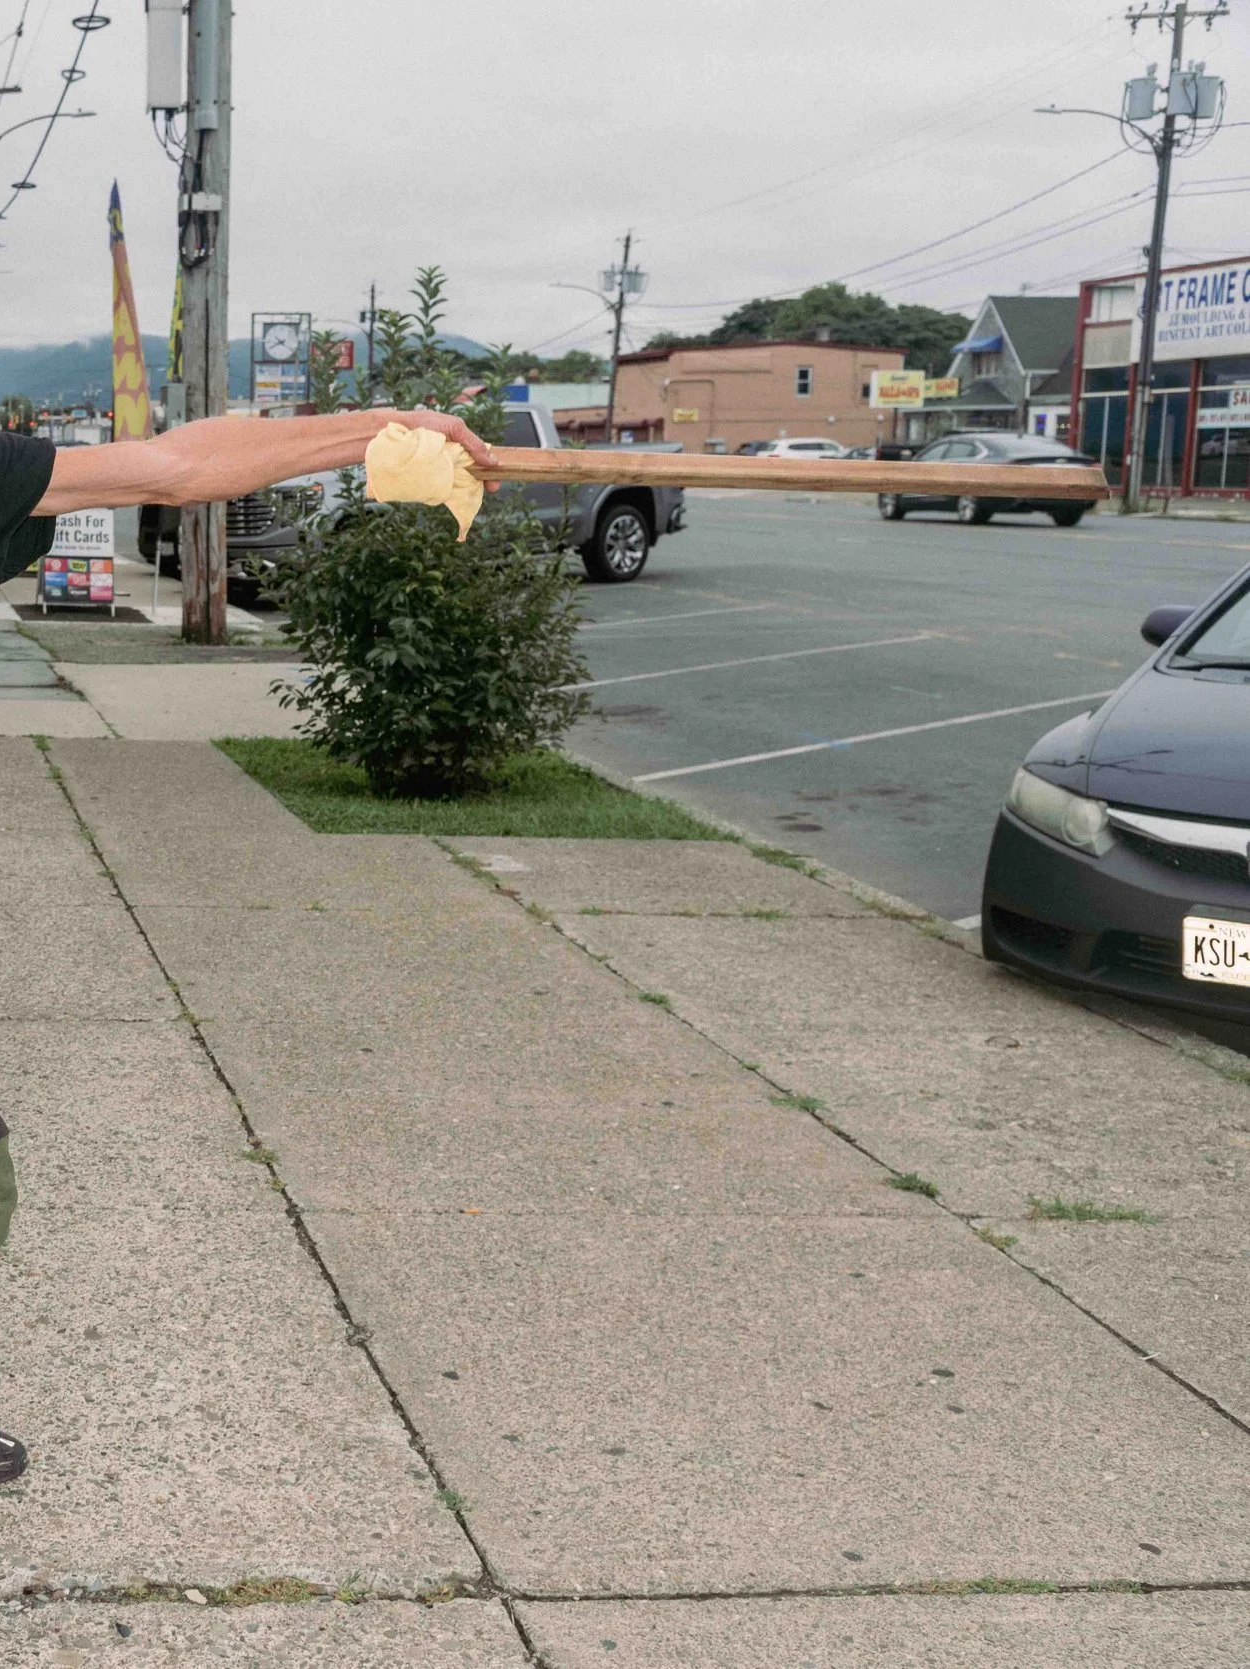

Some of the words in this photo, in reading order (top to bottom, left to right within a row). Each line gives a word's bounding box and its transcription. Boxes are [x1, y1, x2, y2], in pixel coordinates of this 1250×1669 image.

[1175, 271, 1238, 311] FRAME
[1226, 320, 1250, 336] COL
[1233, 390, 1250, 406] SA
[56, 515, 81, 528] ash
[86, 515, 105, 528] For
[55, 530, 70, 543] ift
[74, 531, 110, 544] Cards
[1194, 935, 1236, 968] KSU
